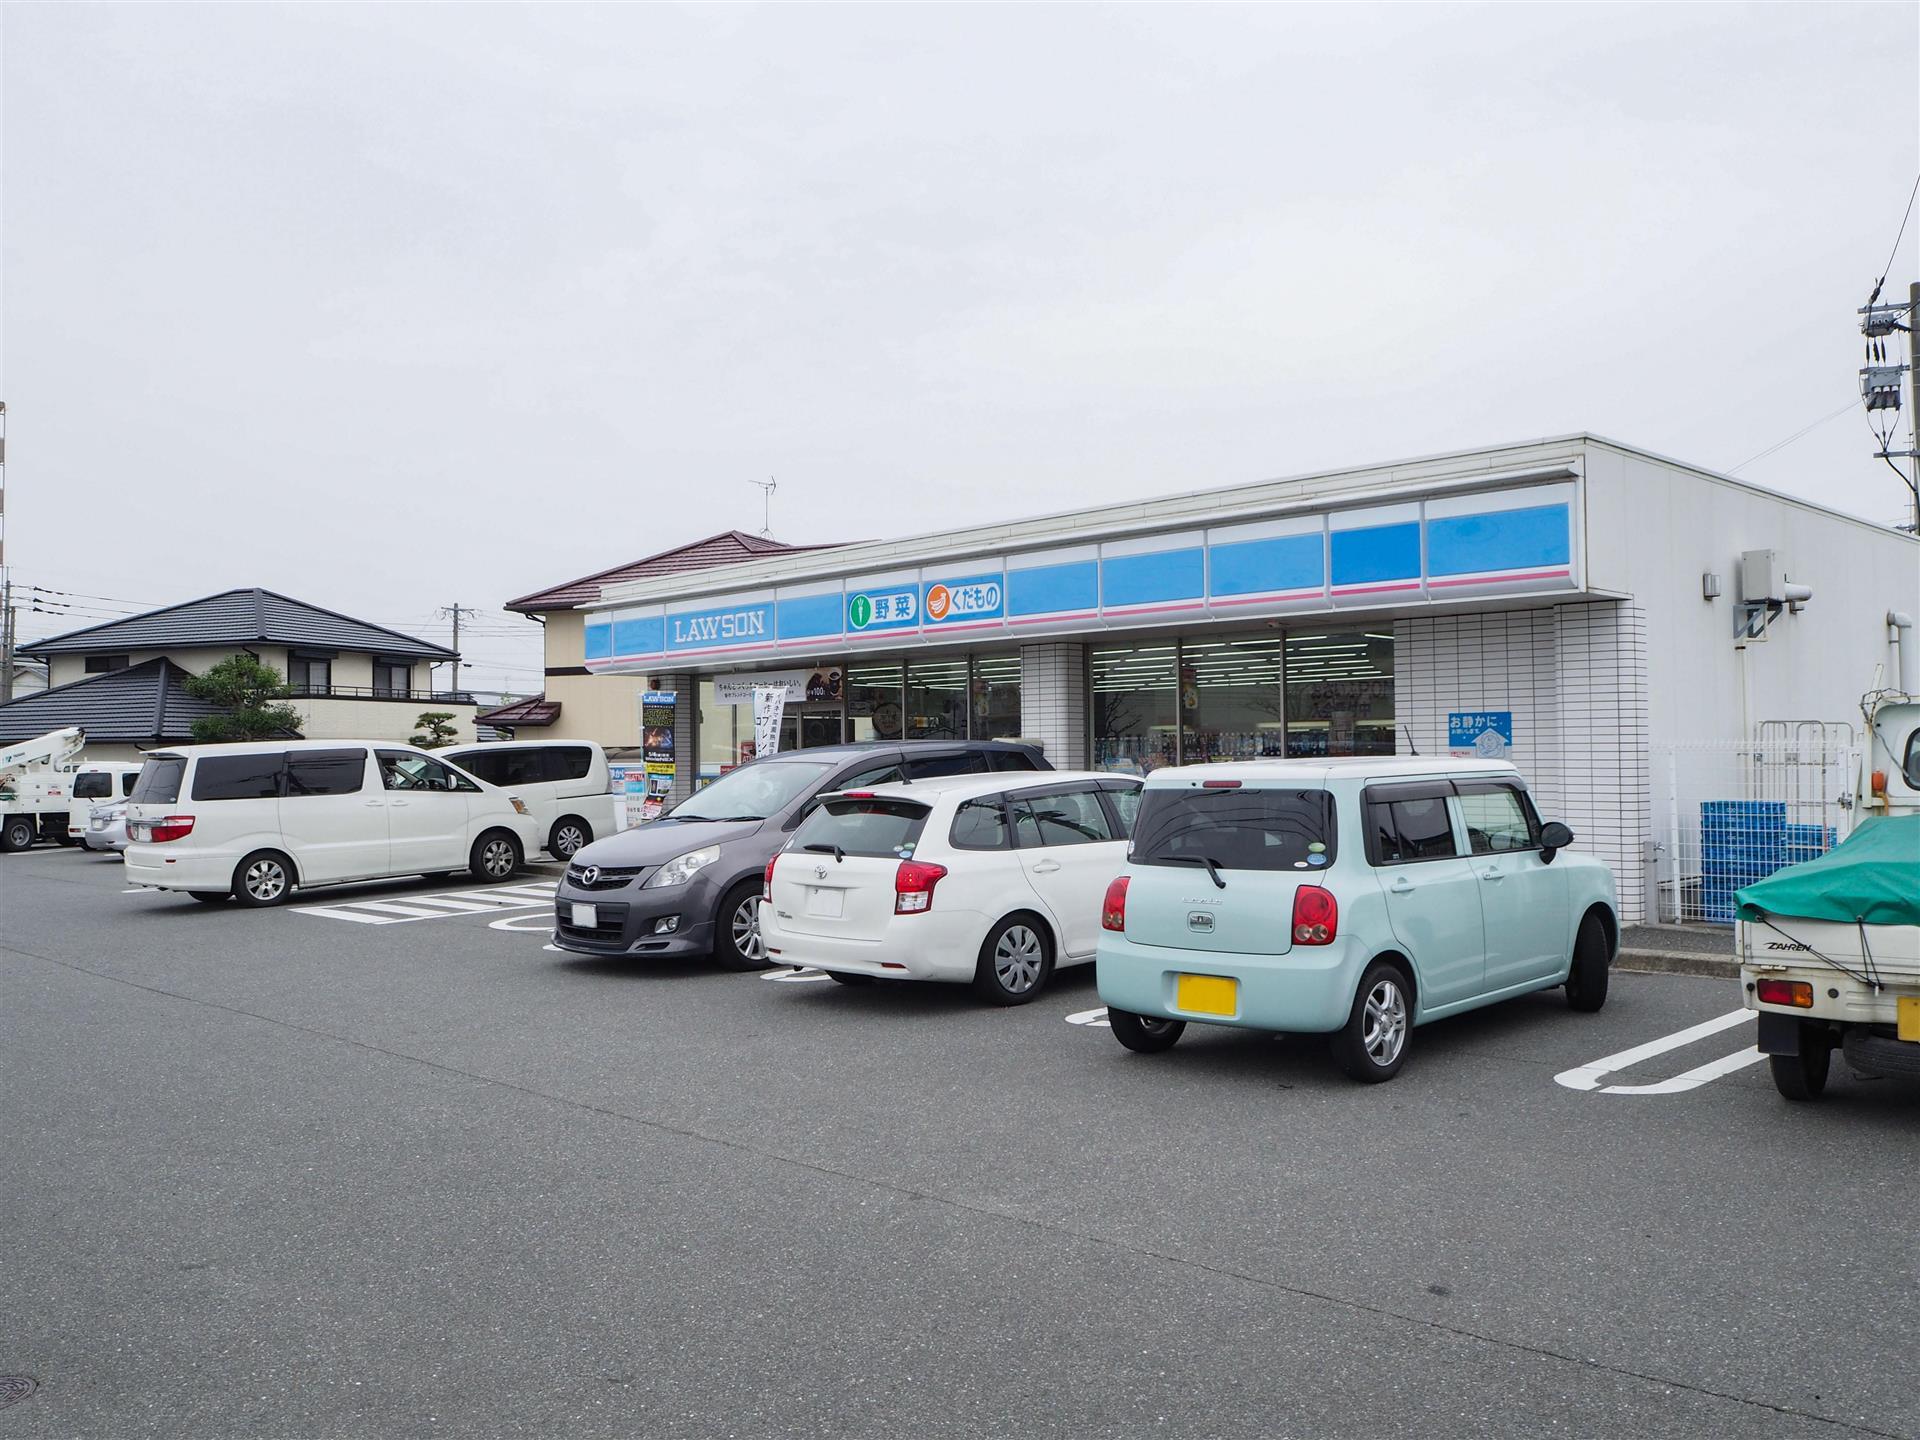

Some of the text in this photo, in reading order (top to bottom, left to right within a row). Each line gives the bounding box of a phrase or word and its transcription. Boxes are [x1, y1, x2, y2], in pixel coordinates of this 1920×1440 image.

[875, 595, 911, 620] 野菜
[952, 586, 998, 611] くだもの
[674, 610, 765, 643] LAWSON
[1450, 715, 1498, 728] お静かに
